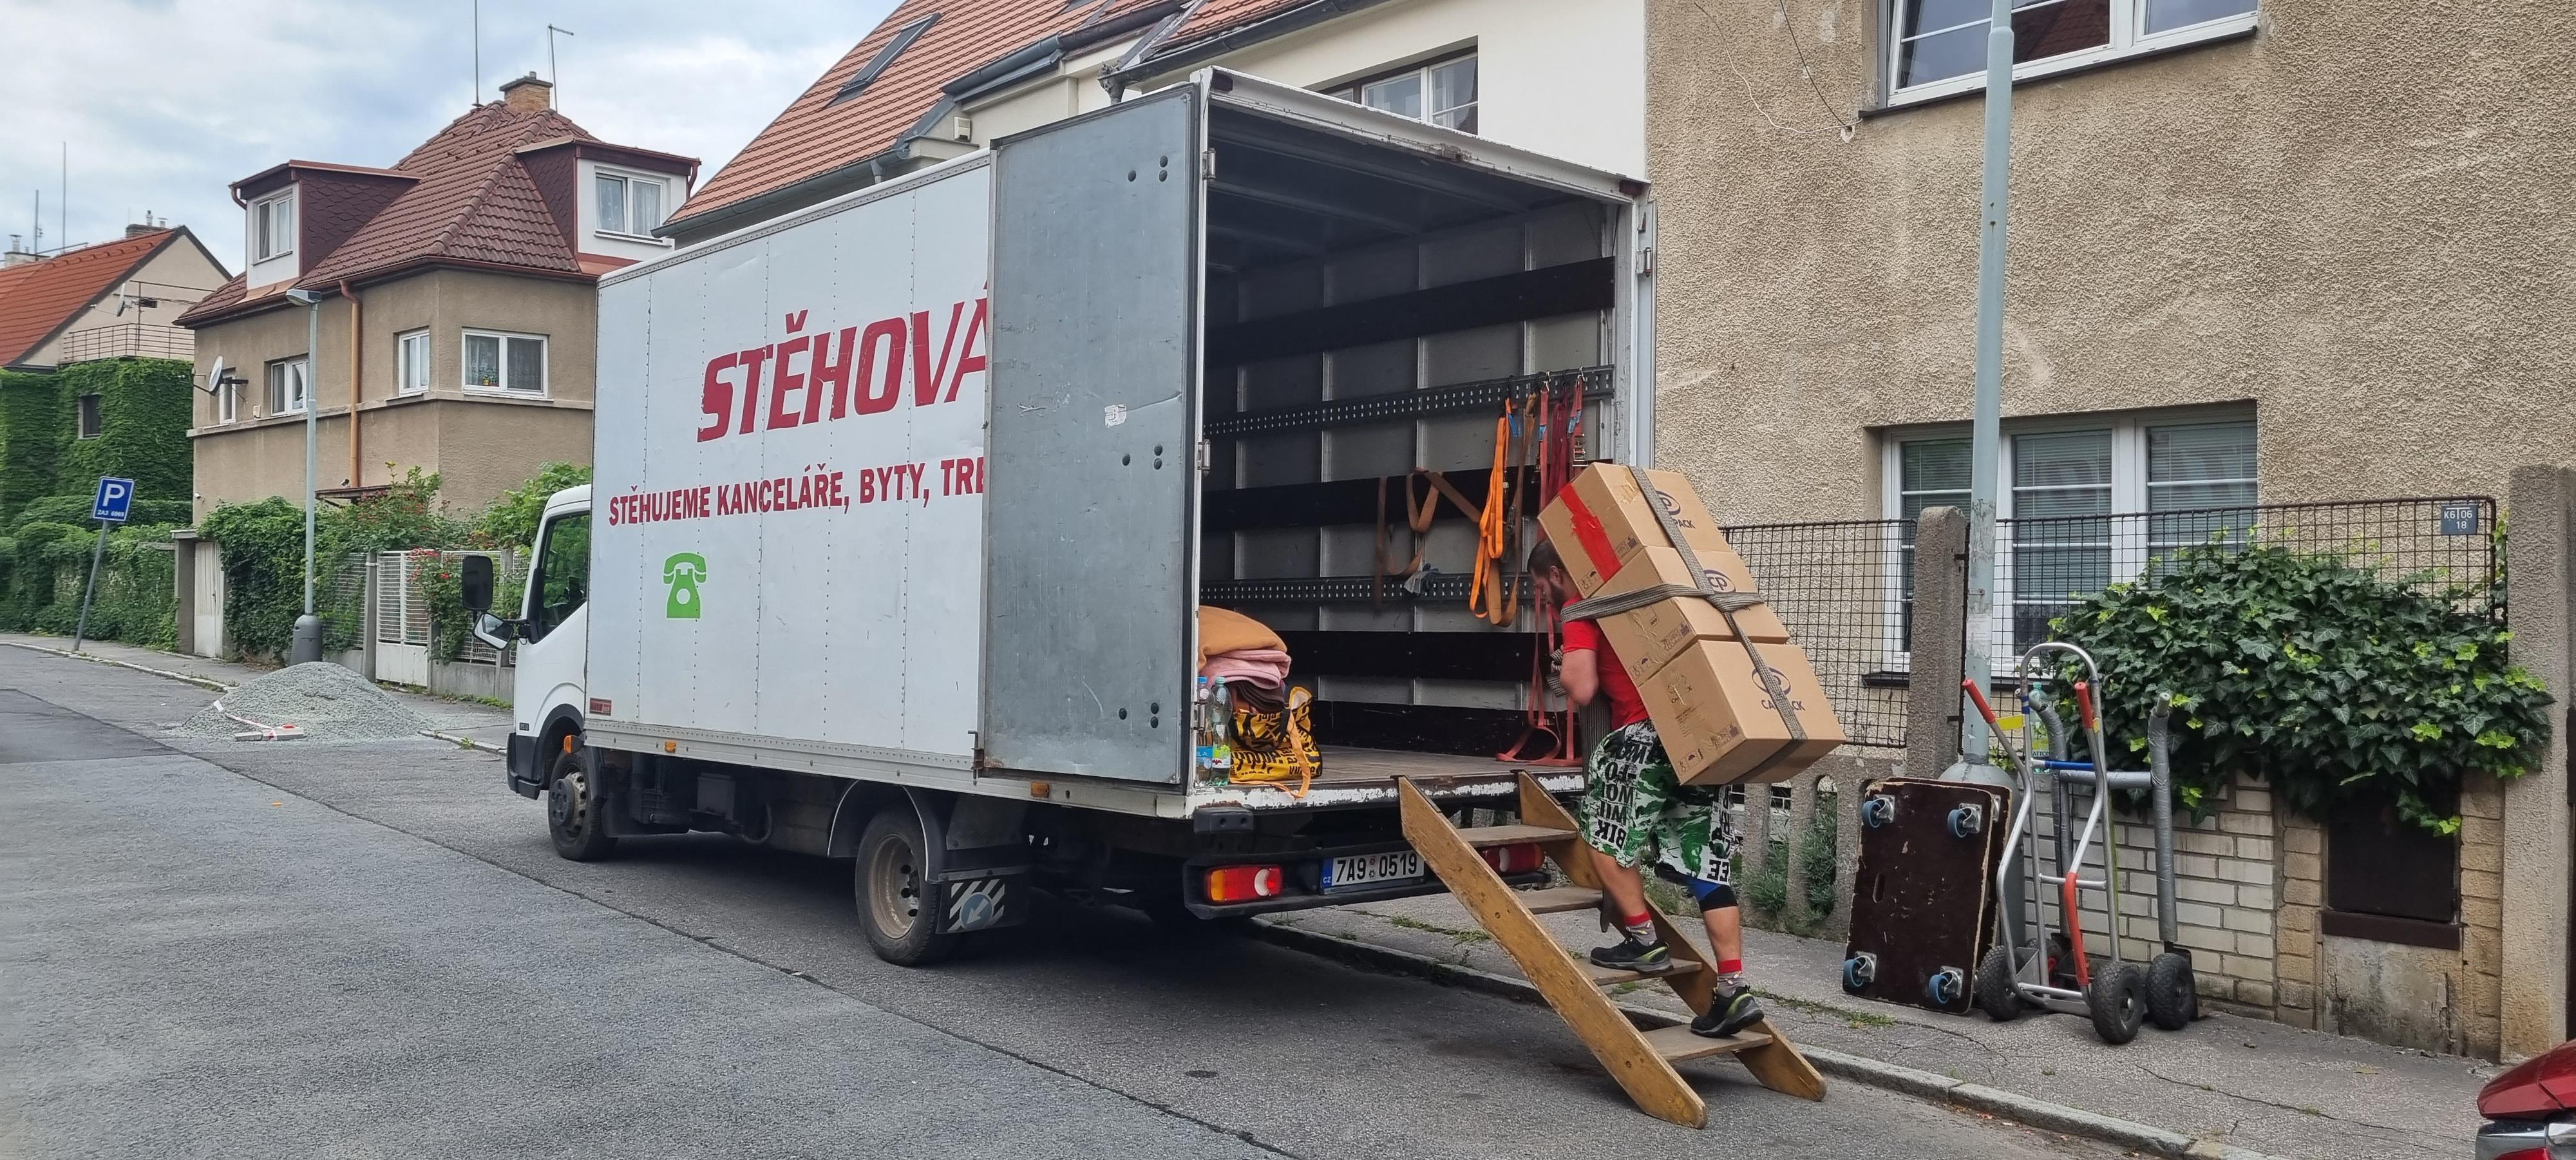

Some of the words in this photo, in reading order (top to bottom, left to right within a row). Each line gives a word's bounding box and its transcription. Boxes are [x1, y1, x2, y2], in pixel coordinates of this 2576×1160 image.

[102, 484, 125, 507] P
[609, 485, 711, 526] STĚHUJEME
[716, 463, 850, 516] KANCELÁŘE,
[860, 462, 930, 508] BYTY,
[2456, 520, 2467, 529] 18
[1761, 699, 1806, 711] CACK
[1336, 857, 1367, 882] 7A9
[1379, 853, 1417, 878] 0519
